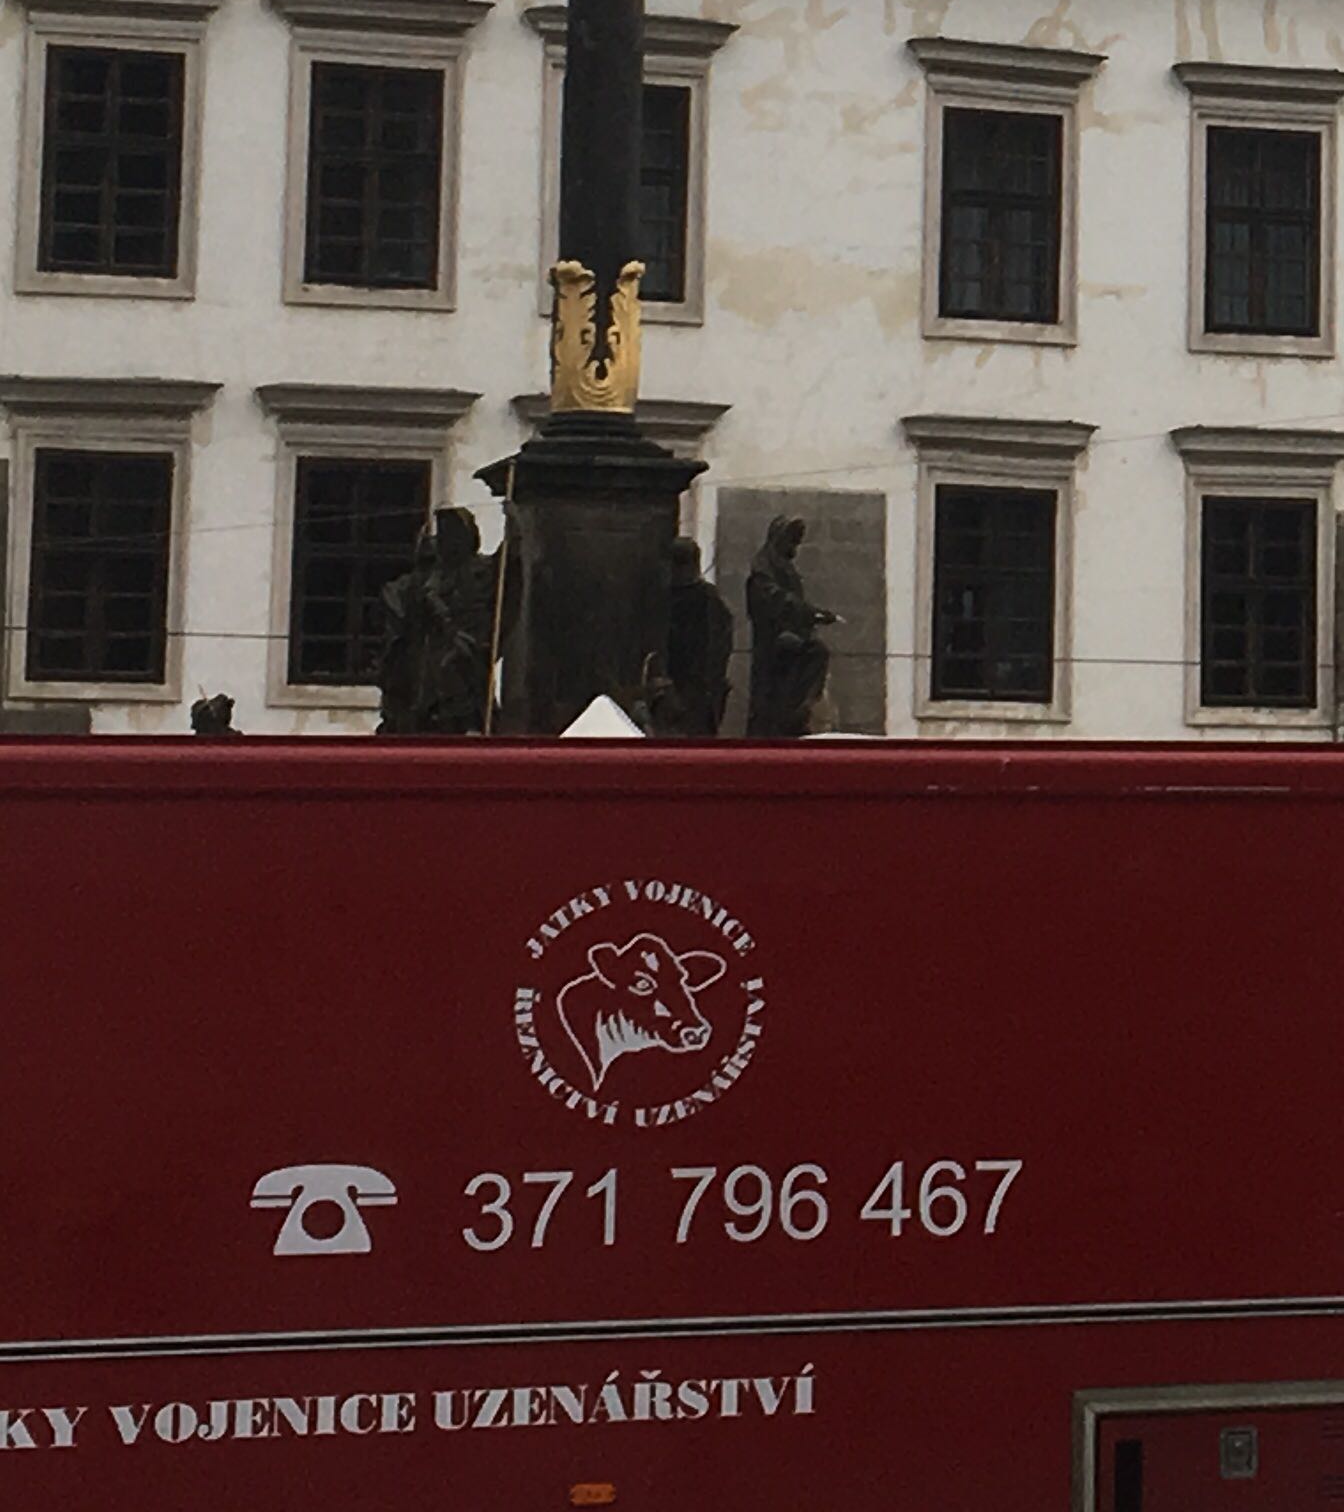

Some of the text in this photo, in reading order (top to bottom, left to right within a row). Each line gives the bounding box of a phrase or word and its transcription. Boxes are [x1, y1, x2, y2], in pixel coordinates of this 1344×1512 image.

[526, 880, 755, 958] JATKY VOJENICE
[462, 1160, 1023, 1251] 371 796 467
[108, 1392, 416, 1445] VOJENICE
[432, 1363, 816, 1430] UZENÁŘSTVÍ
